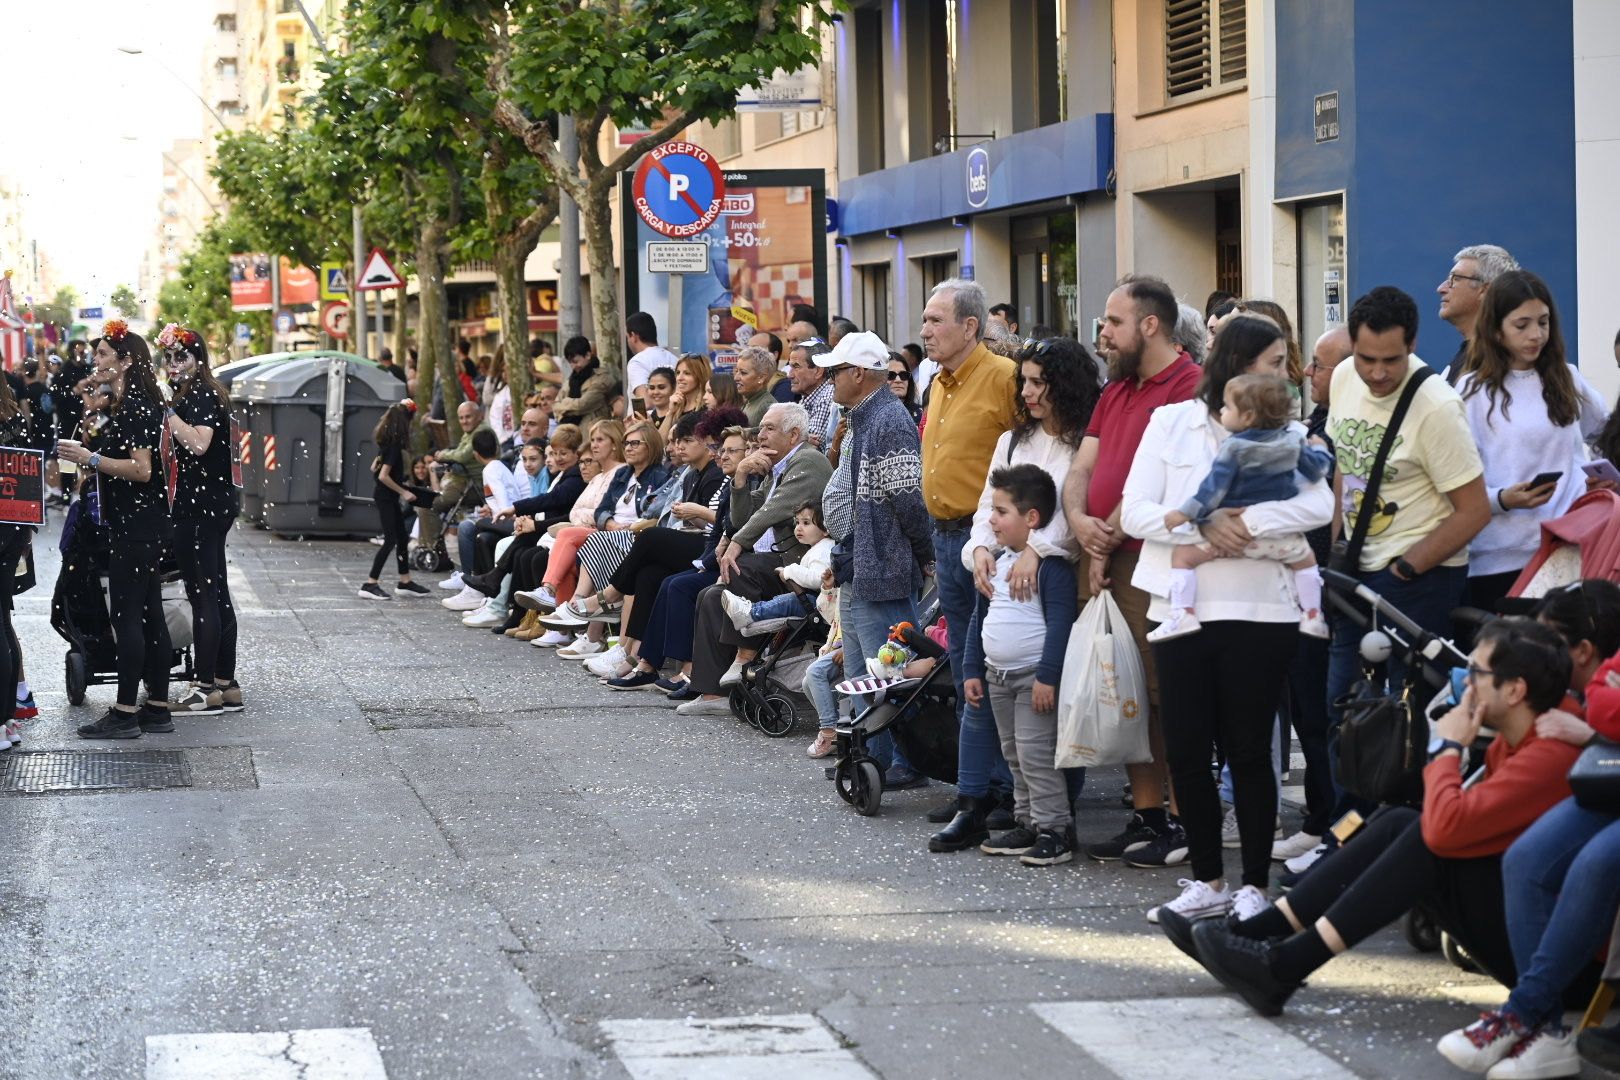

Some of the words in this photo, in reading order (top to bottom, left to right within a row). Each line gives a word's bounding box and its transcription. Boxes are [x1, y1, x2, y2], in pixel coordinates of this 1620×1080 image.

[651, 143, 708, 163] EXCEPTO
[669, 174, 690, 201] P
[636, 197, 663, 232] CARGA
[665, 224, 674, 234] Y
[674, 199, 721, 235] DESCARGA
[731, 219, 767, 232] Integral
[734, 309, 756, 324] NUEVO
